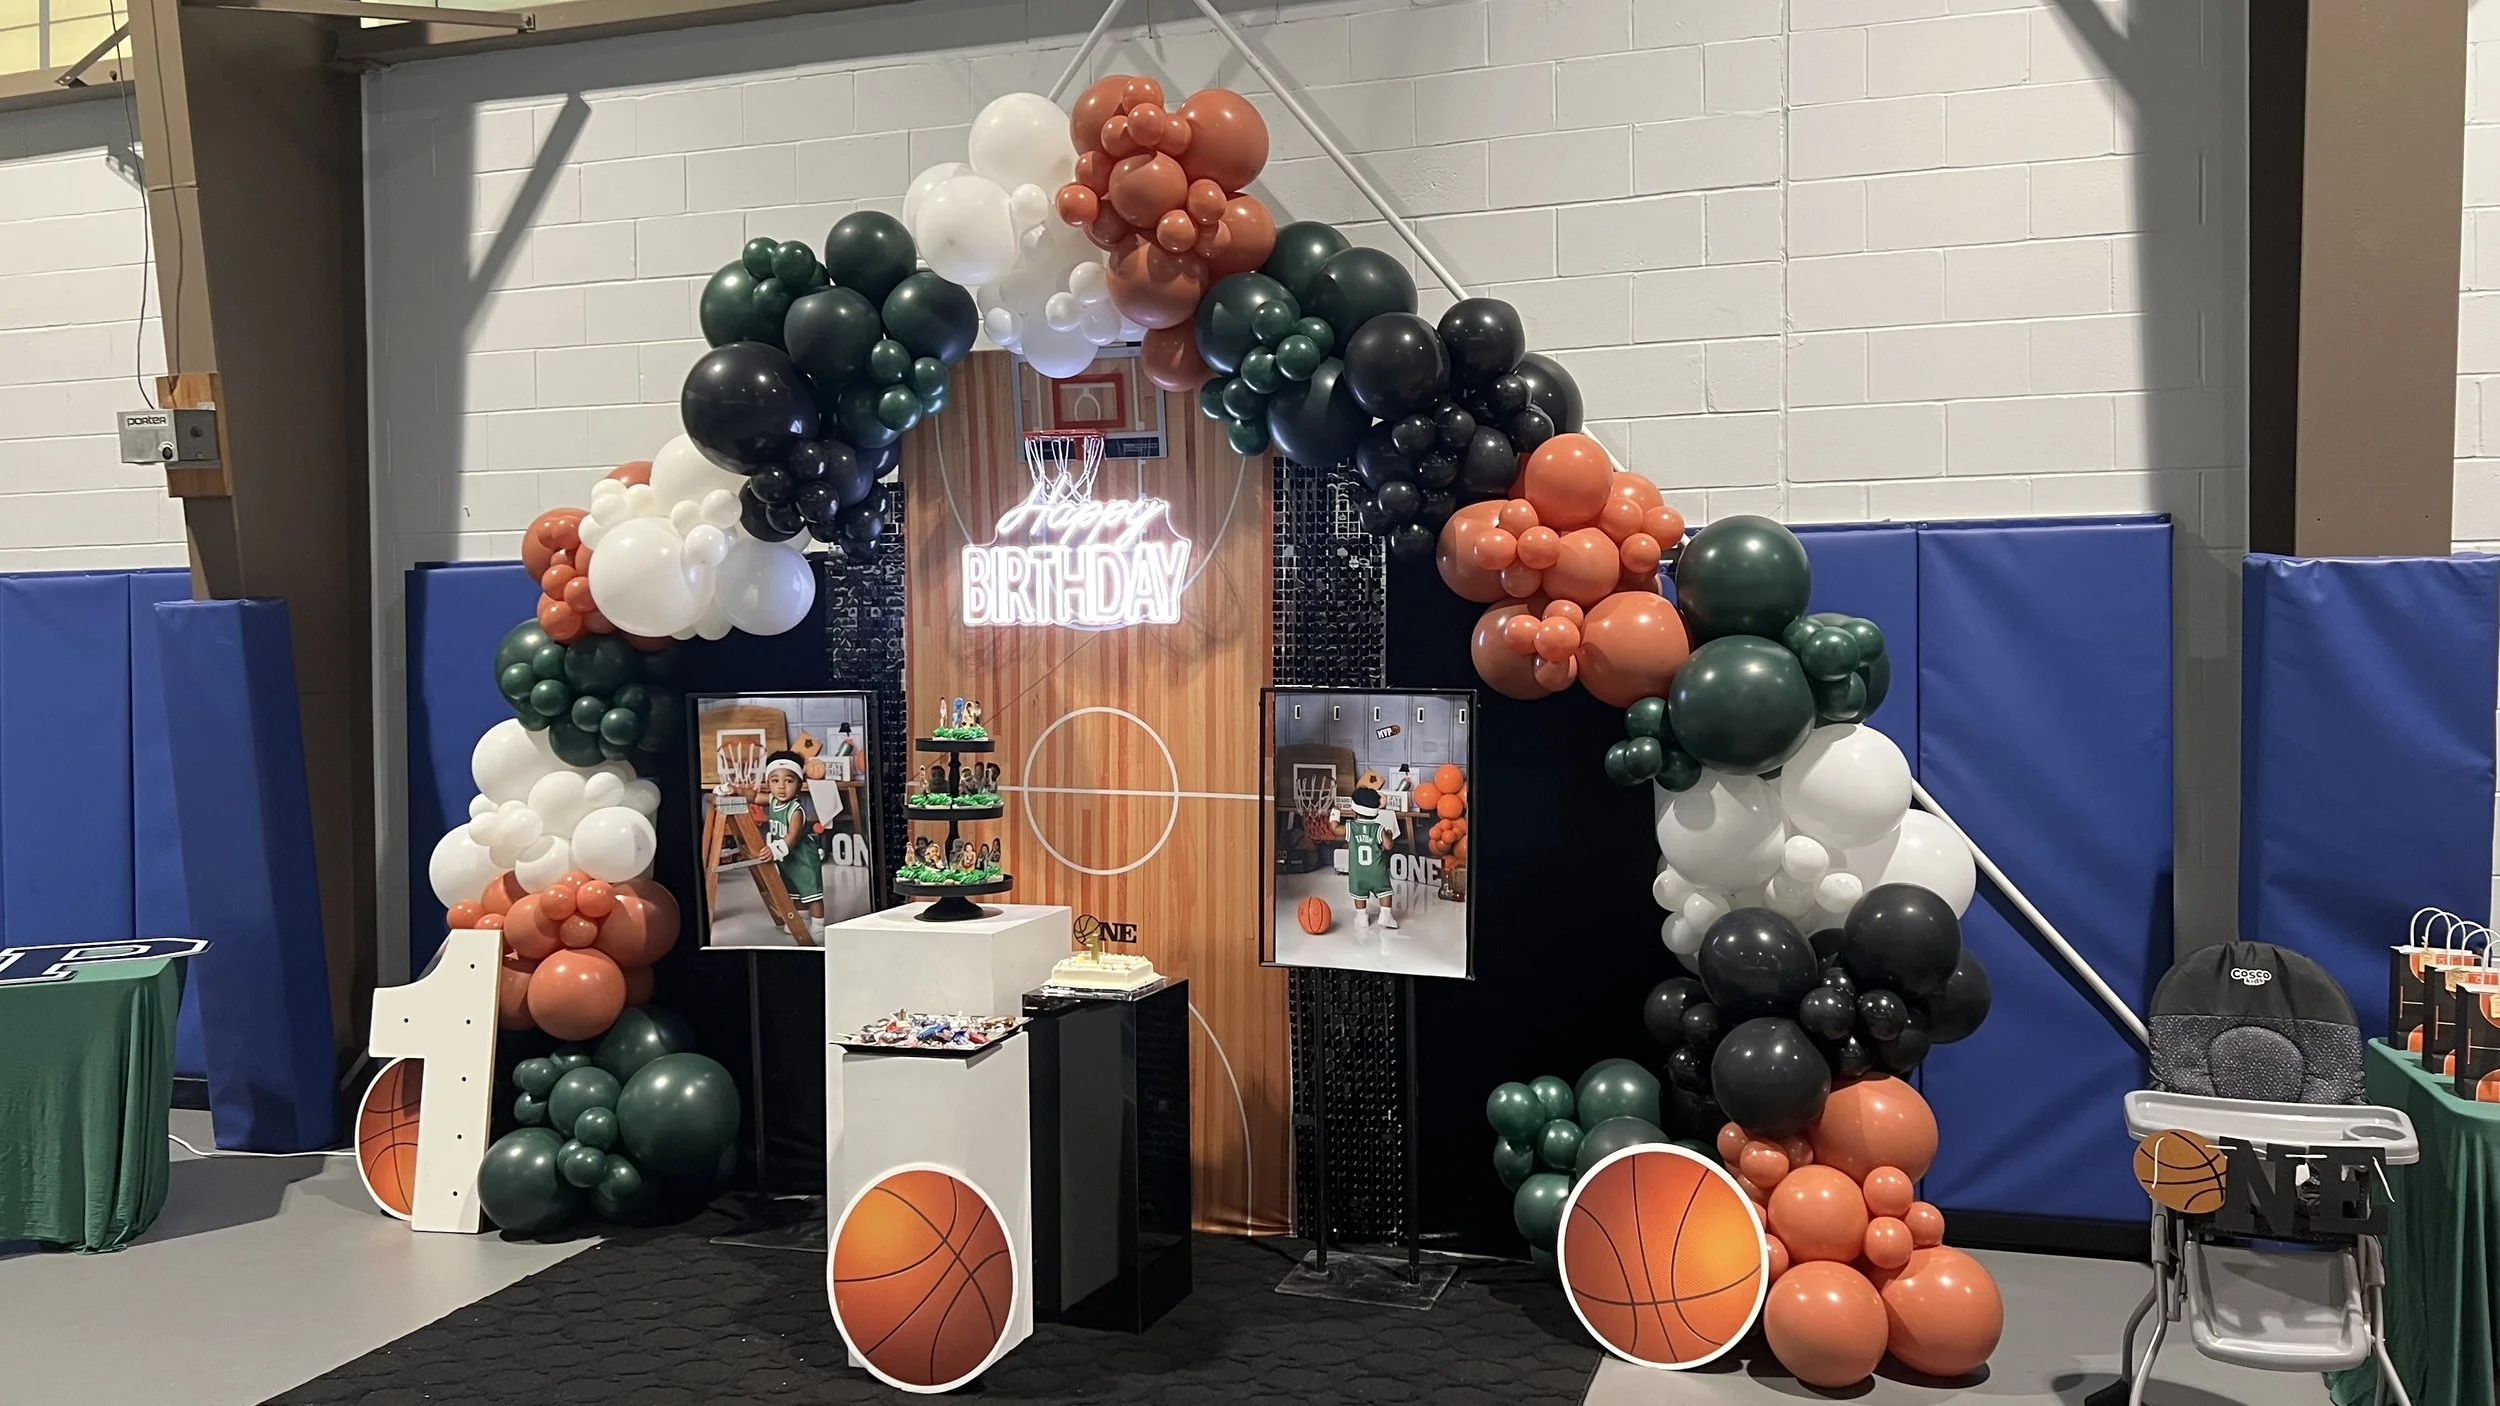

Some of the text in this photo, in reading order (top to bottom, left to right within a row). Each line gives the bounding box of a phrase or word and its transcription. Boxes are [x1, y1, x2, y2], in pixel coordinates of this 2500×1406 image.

[998, 475, 1167, 550] Happy
[962, 542, 1190, 625] BIRTHDAY
[1377, 727, 1392, 739] MVP
[1390, 853, 1442, 888] ONE
